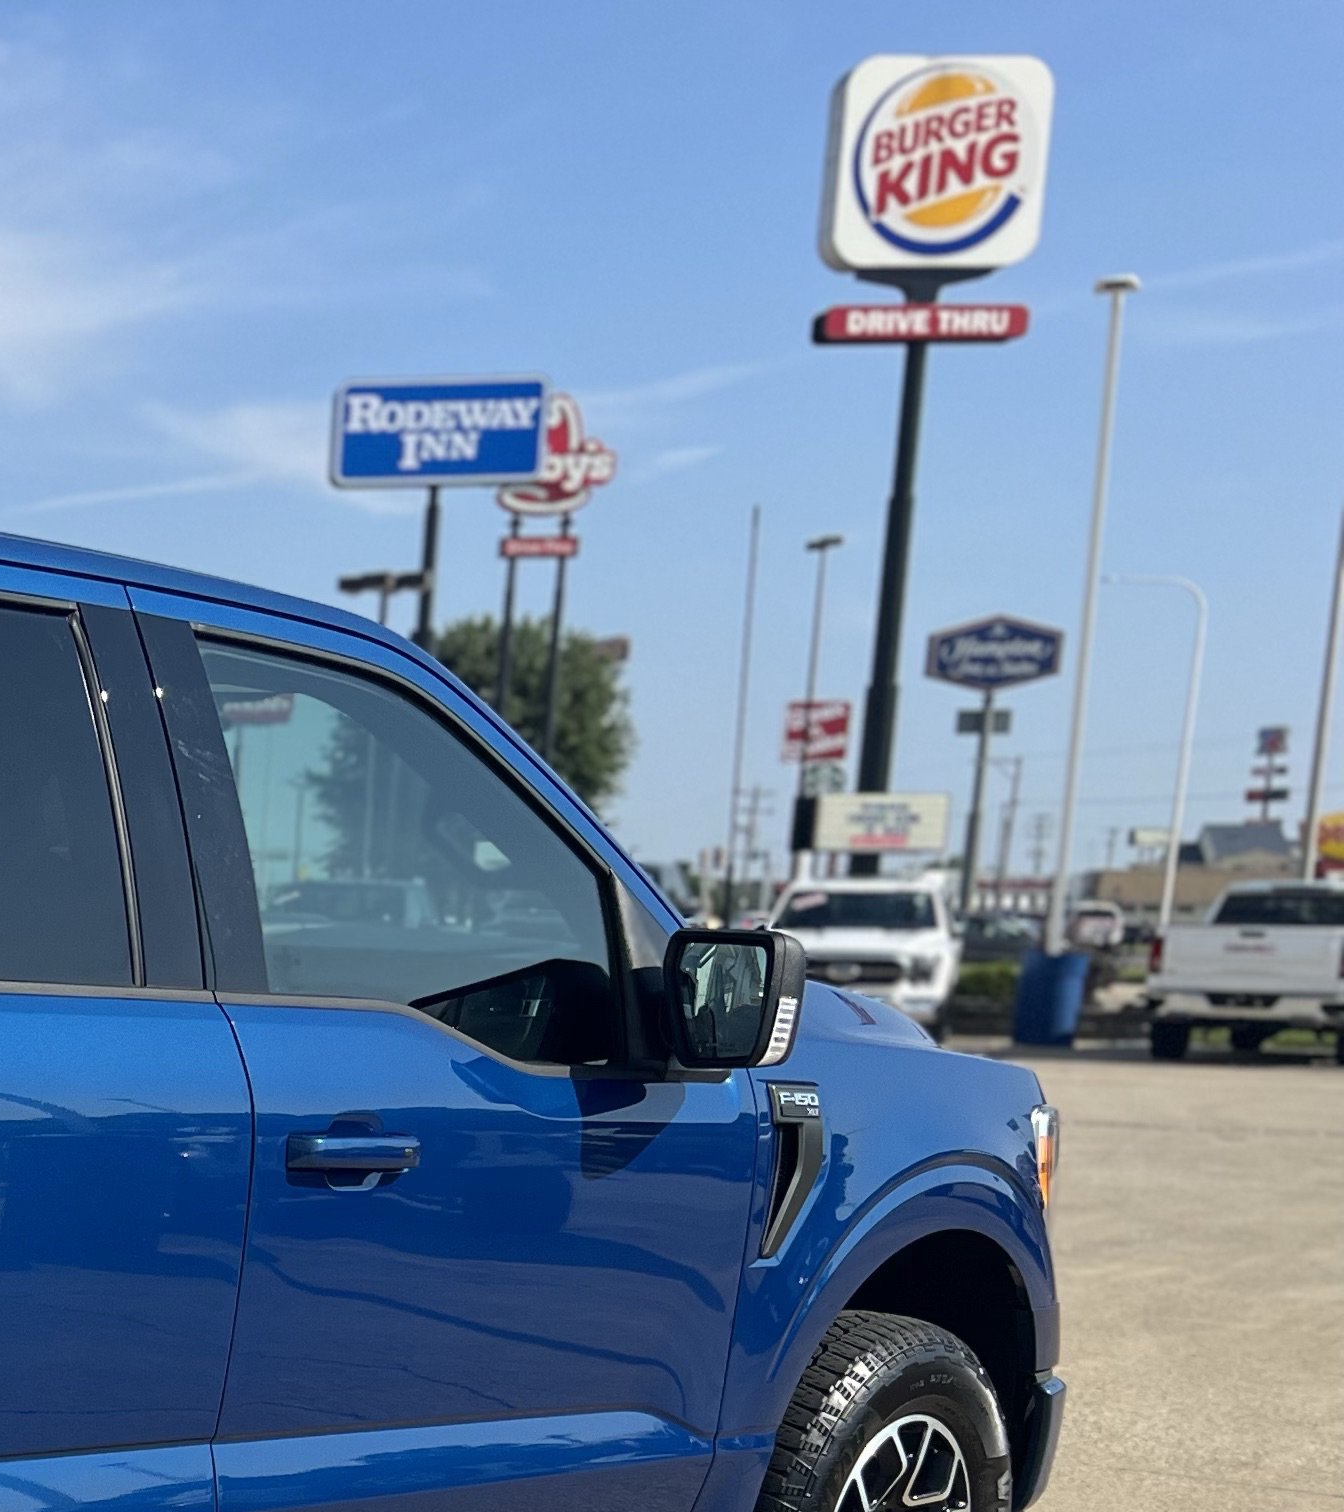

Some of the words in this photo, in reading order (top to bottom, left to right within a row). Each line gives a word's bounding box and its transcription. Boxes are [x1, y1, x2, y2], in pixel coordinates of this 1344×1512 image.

[871, 98, 1017, 166] BURGER
[875, 132, 1020, 216] KING
[845, 309, 930, 335] DRIVE
[937, 308, 1011, 334] THRU
[345, 394, 541, 434] RODEWAY
[398, 431, 480, 470] INN
[778, 1091, 819, 1106] F-150
